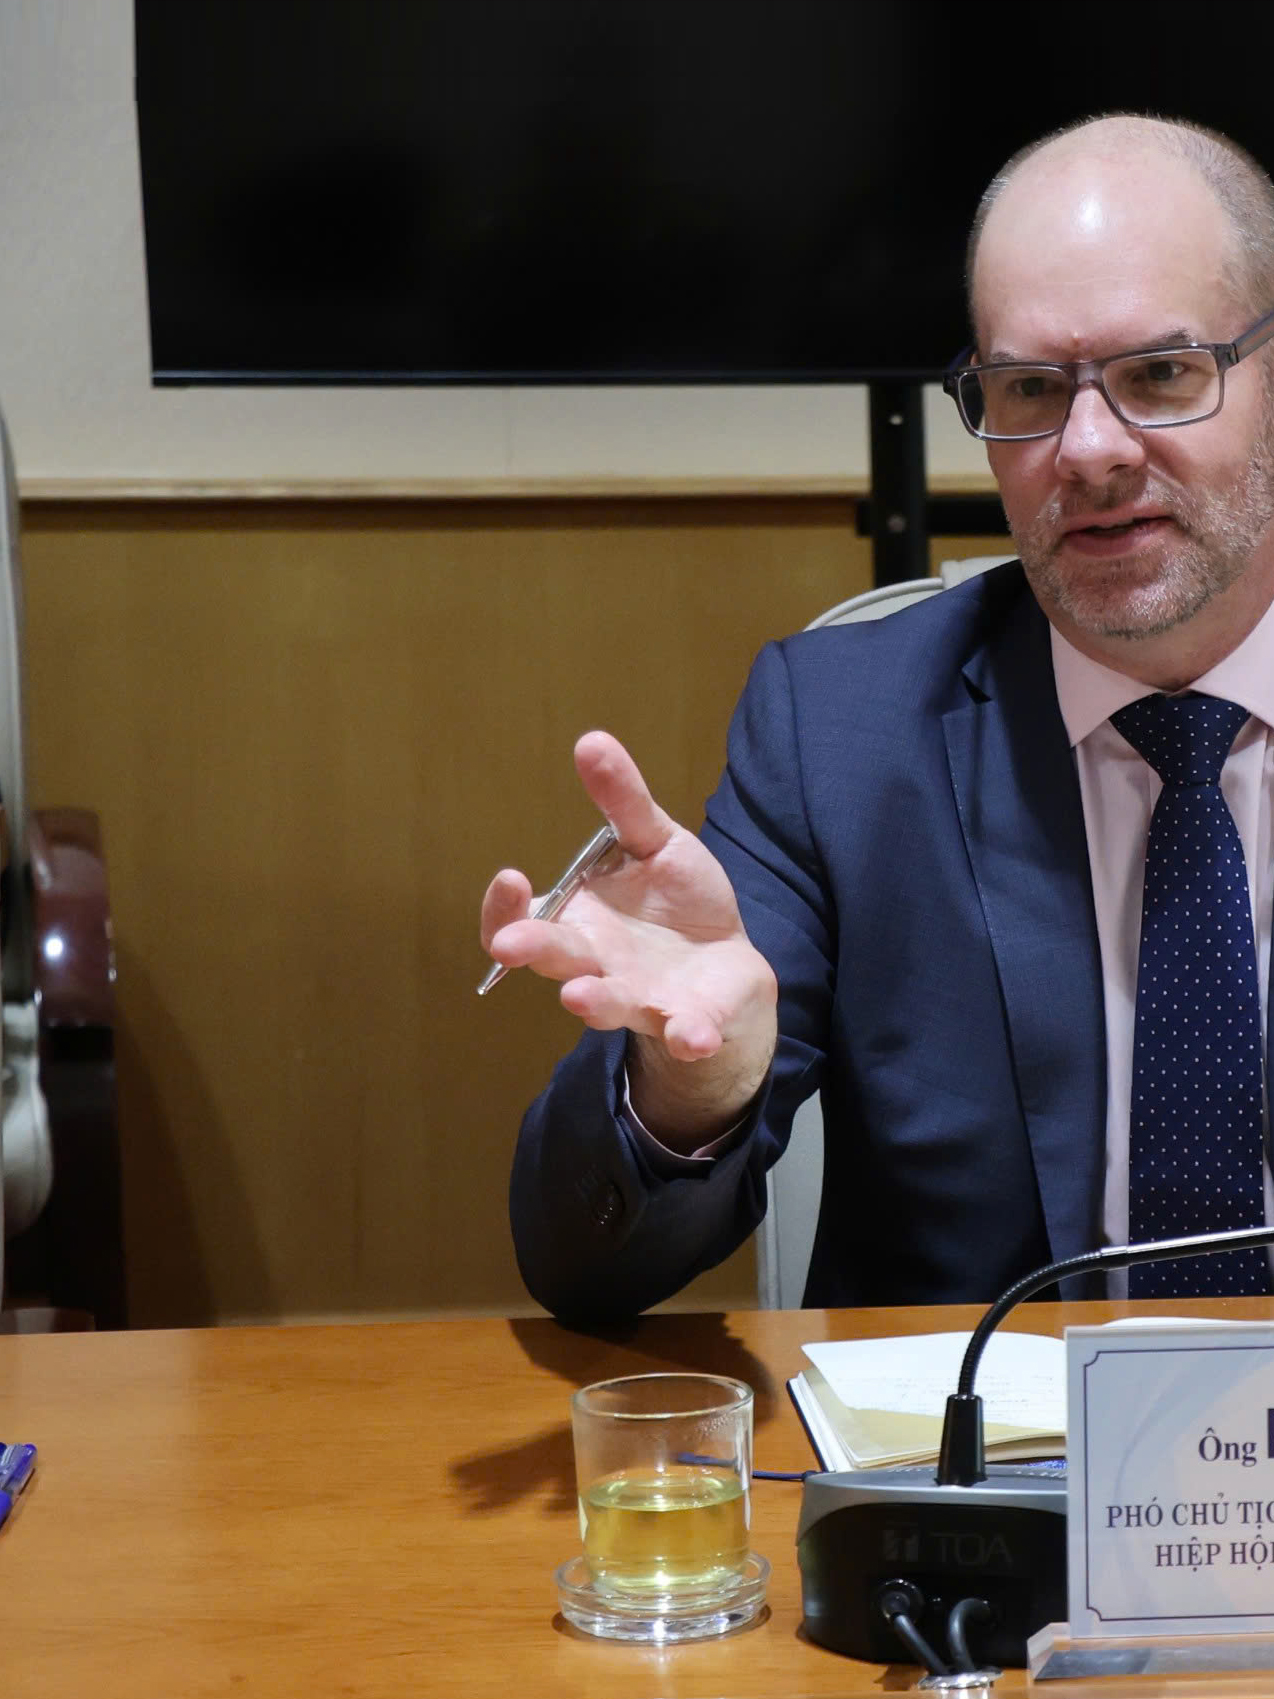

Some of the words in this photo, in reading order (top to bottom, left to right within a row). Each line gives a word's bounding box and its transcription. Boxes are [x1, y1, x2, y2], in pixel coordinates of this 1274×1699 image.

[1198, 1427, 1258, 1468] Ông
[1105, 1496, 1164, 1529] PHÓ
[1171, 1492, 1230, 1527] CHỦ
[929, 1532, 1014, 1565] TOA
[1155, 1536, 1222, 1573] HIỆP
